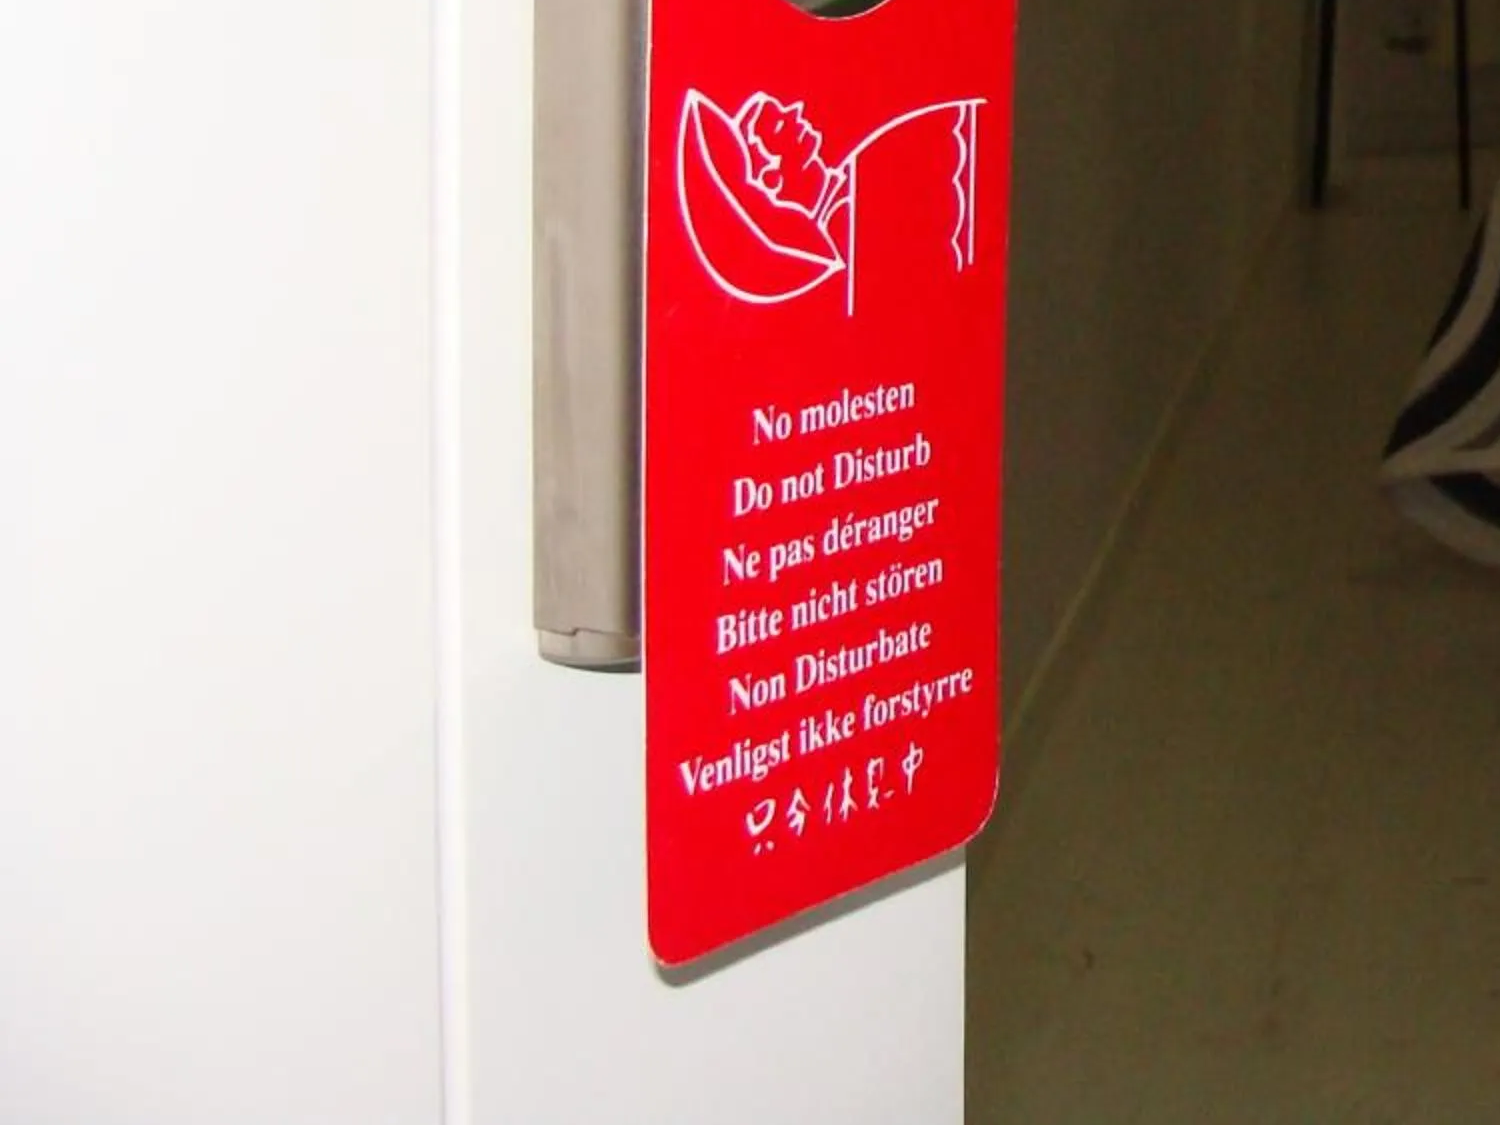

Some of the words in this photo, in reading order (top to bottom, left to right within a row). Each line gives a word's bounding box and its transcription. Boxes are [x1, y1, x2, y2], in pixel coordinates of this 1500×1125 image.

[752, 405, 793, 446] No
[799, 382, 915, 435] molesten
[733, 476, 774, 517] Do
[780, 462, 825, 505] not
[833, 432, 932, 490] Disturb
[722, 543, 762, 586] Ne
[769, 517, 815, 583] pas
[822, 498, 940, 556] déranger
[716, 607, 784, 655] Bitte
[791, 578, 858, 631] nicht
[865, 558, 943, 606] stören
[728, 673, 787, 716] Non
[795, 622, 932, 694] Disturbate
[679, 730, 791, 797] Venligst
[799, 709, 856, 756] ikke
[863, 667, 974, 732] forstyrre
